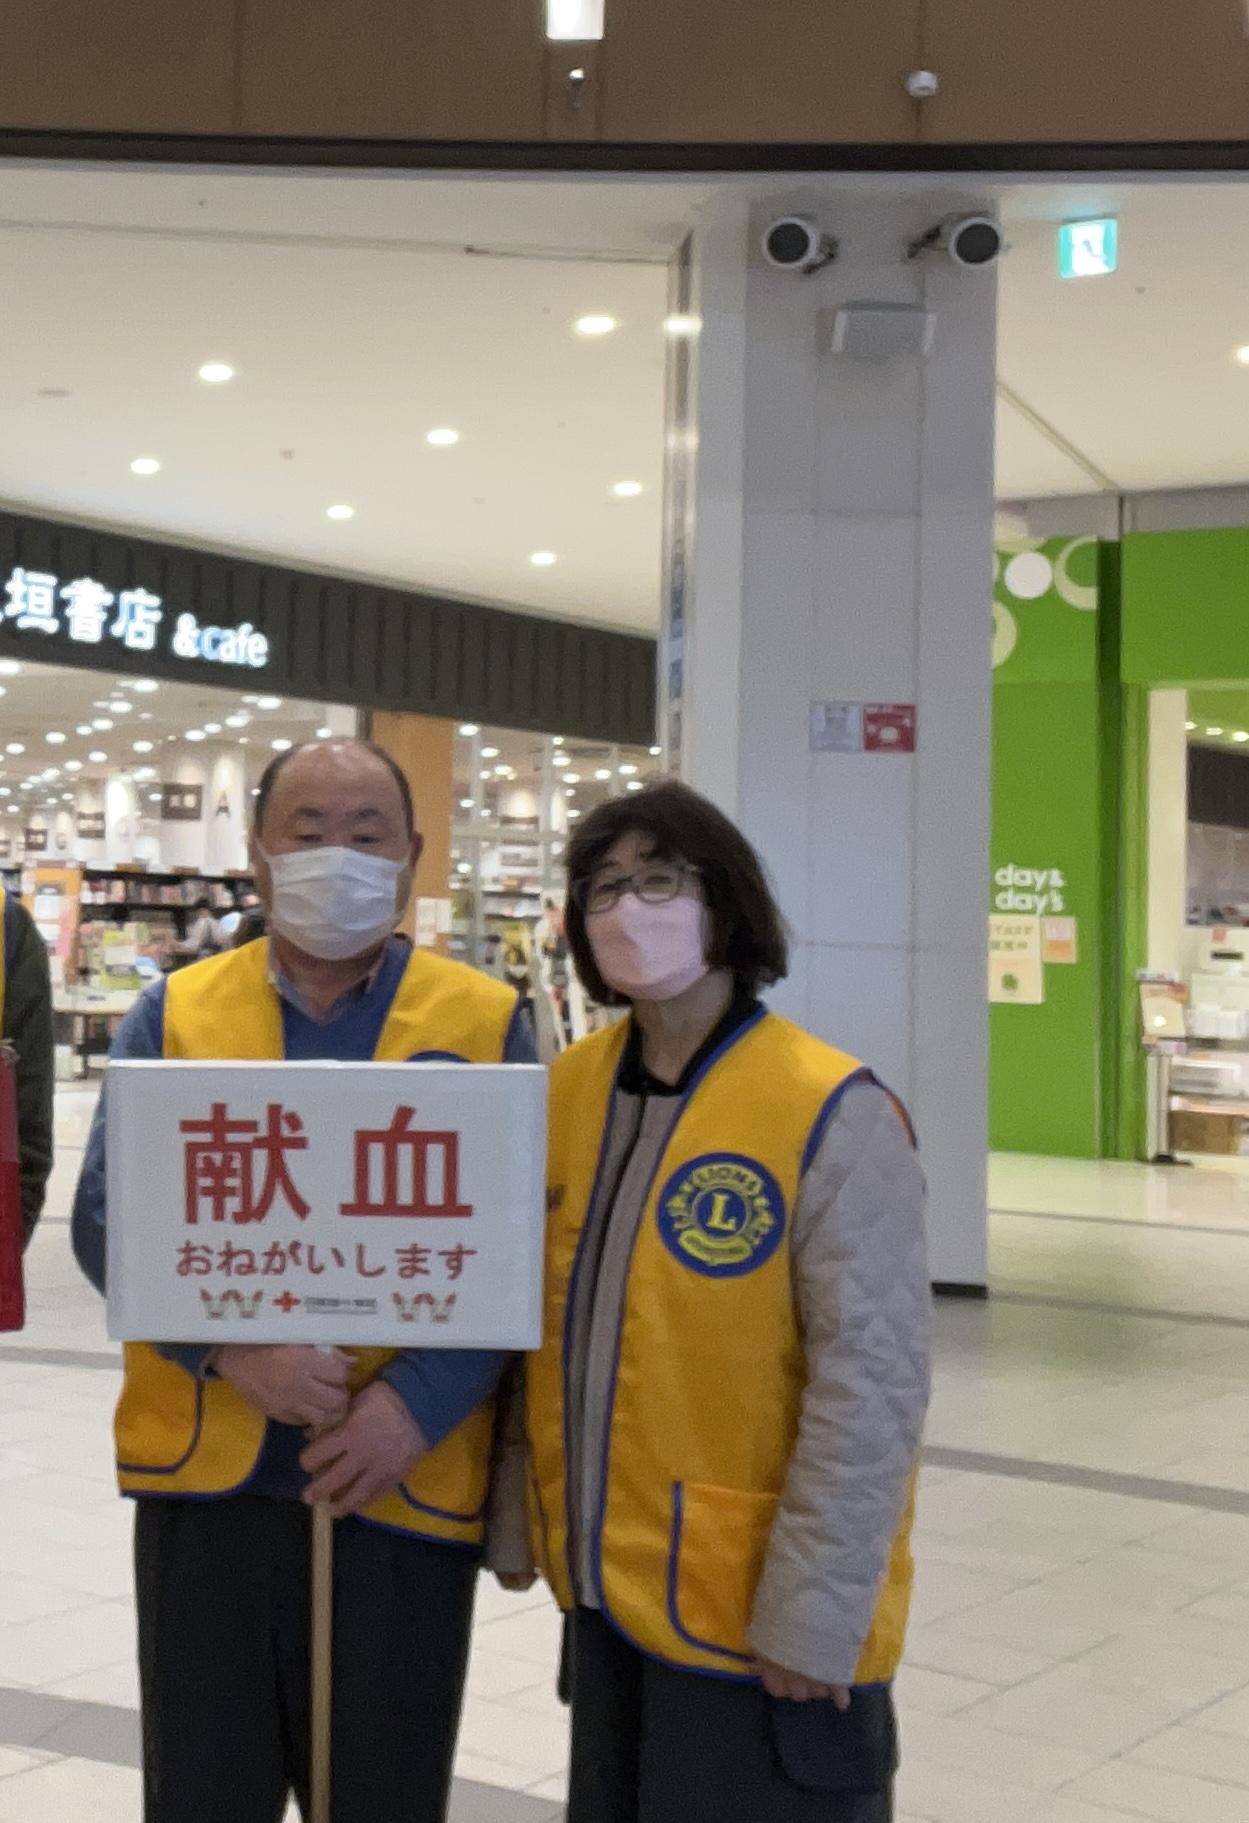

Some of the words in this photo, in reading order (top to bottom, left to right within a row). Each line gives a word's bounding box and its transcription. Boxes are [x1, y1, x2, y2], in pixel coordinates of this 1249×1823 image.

[172, 613, 269, 668] &cafe
[179, 1103, 473, 1224] 献血
[176, 1239, 477, 1280] おねがいします
